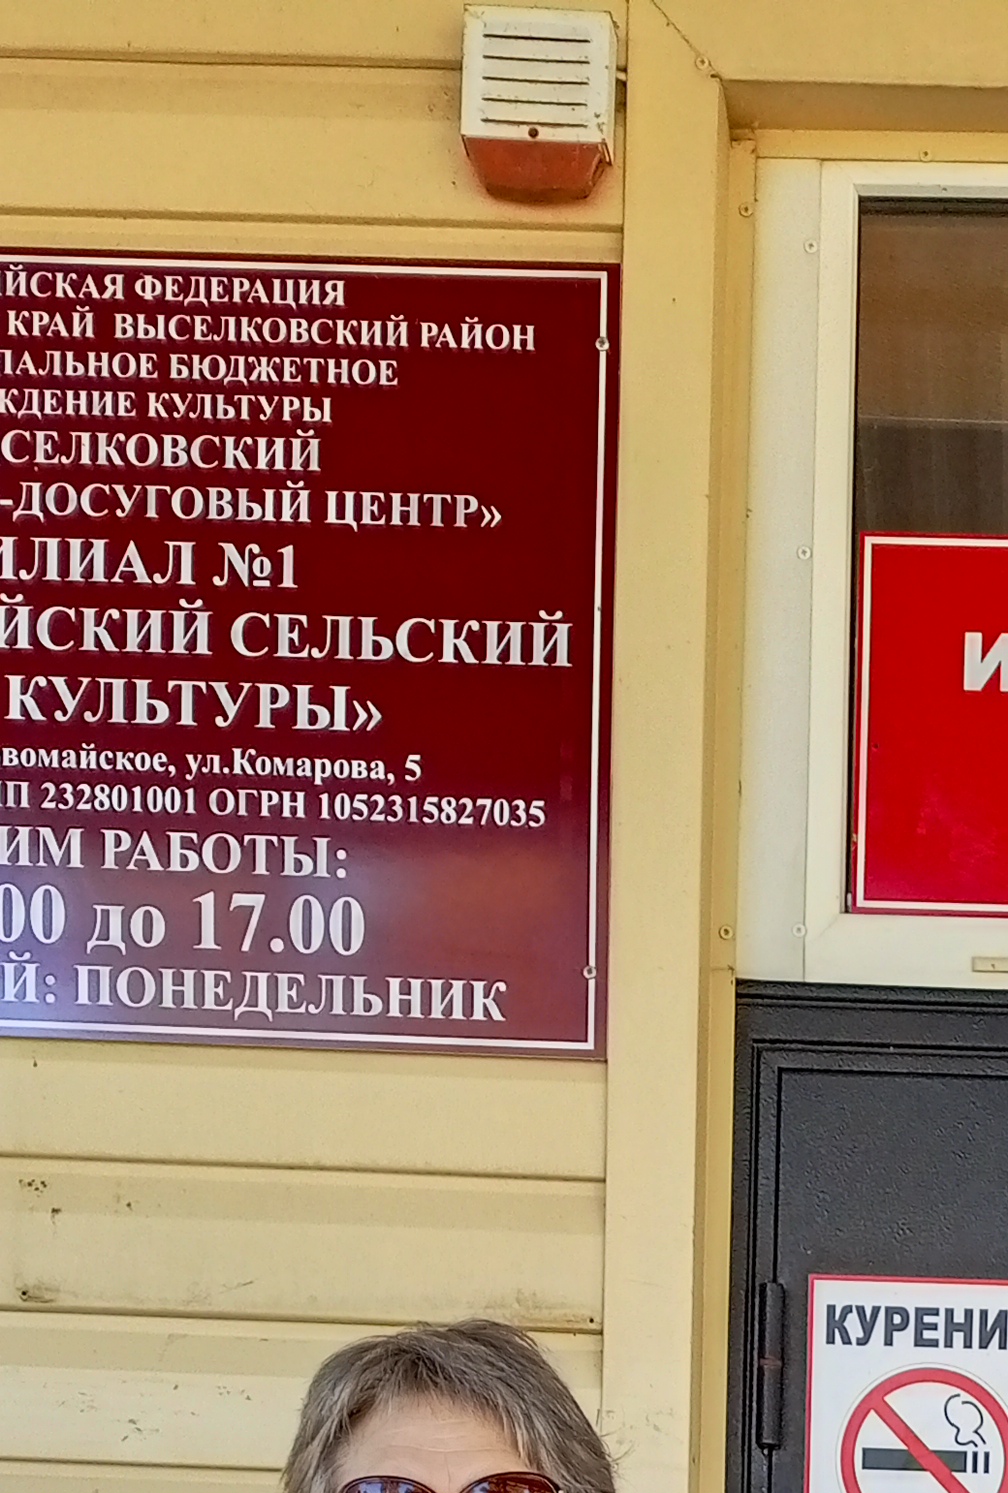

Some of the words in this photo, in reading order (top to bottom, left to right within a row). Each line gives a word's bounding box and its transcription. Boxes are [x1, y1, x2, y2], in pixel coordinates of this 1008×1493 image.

[0, 264, 124, 299] ЙСКАЯ
[135, 275, 344, 309] ФЕДЕРАЦИЯ
[7, 305, 94, 338] КРАЙ
[115, 314, 408, 347] ВЫСЕЛКОВСКИЙ
[421, 317, 534, 350] РАЙОН
[170, 354, 397, 386] БЮДЖЕТНОЕ
[148, 393, 331, 422] КУЛЬТУРЫ
[1, 429, 321, 471] СЕЛКОВСКИЙ
[325, 491, 501, 532] ЦЕНТР»
[213, 543, 298, 588] №1
[231, 610, 572, 666] СЕЛЬСКИЙ
[4, 675, 381, 731] КУЛЬТУРЫ»
[2, 743, 176, 777] вомайское,
[186, 748, 394, 785] ул.Комарова,
[405, 755, 421, 781] 5
[41, 782, 196, 813] 232801001
[209, 789, 305, 818] ОГРН
[319, 793, 545, 827] 1052315827035
[101, 830, 346, 878] РАБОТЫ:
[87, 905, 165, 955] до
[193, 892, 364, 955] 17.00
[0, 952, 55, 1003] Й:
[74, 965, 506, 1021] ПОНЕДЕЛЬНИК
